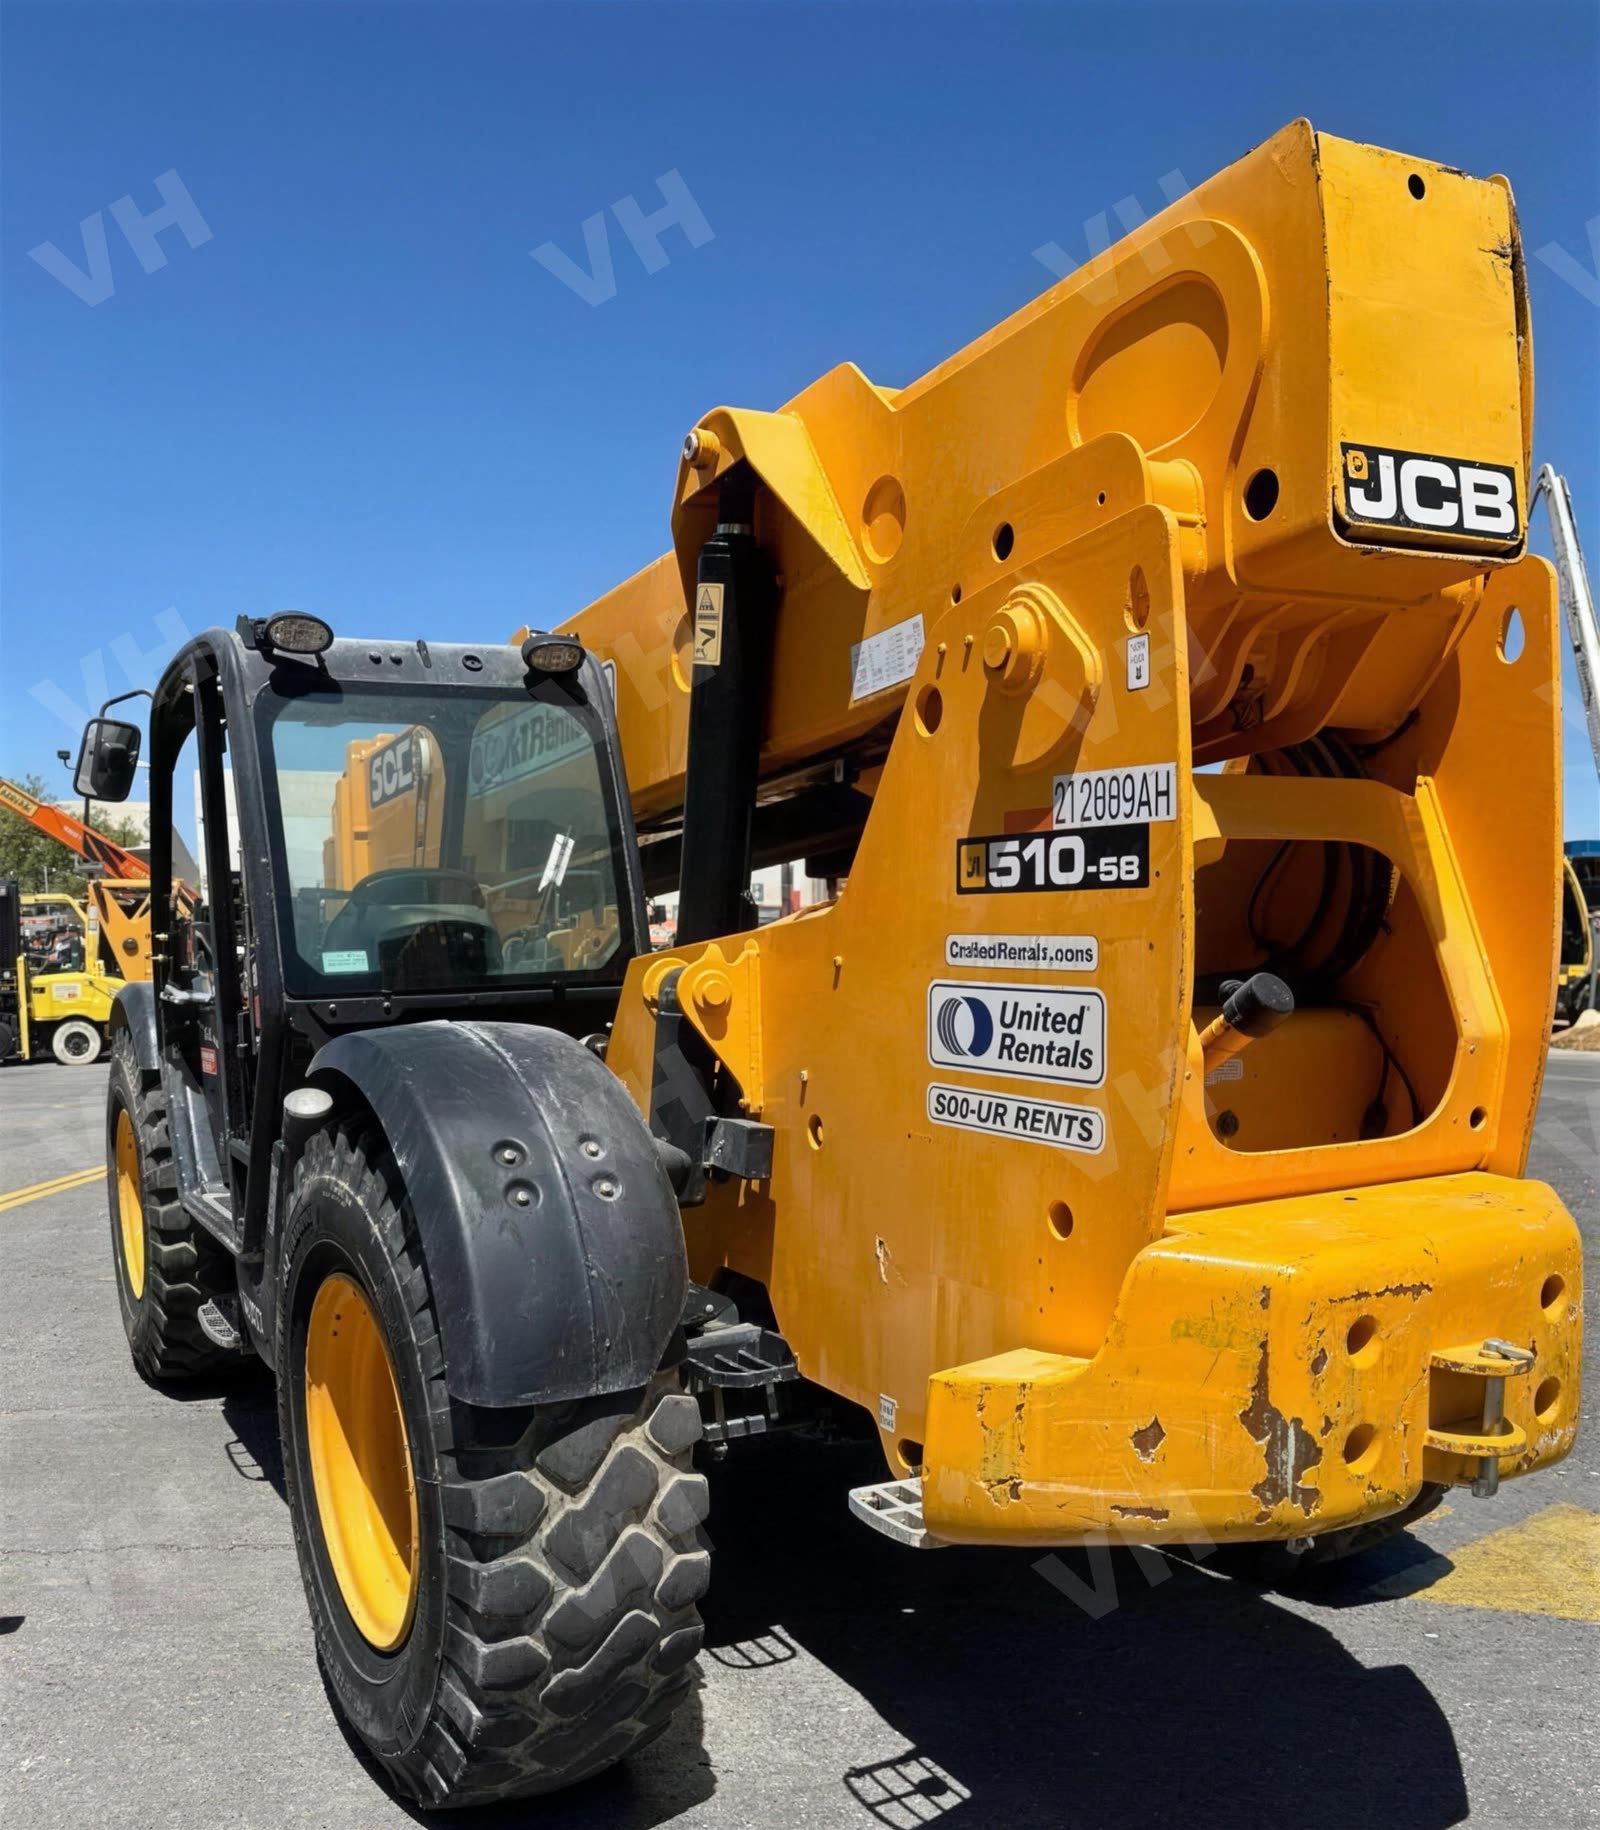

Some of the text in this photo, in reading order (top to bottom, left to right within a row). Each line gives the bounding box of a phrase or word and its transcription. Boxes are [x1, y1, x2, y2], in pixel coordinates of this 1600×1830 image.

[1349, 454, 1516, 534] JCB
[988, 835, 1140, 888] 510-58
[1000, 1001, 1086, 1035] United
[998, 1033, 1094, 1070] Rentals
[1014, 1106, 1094, 1142] RENTS
